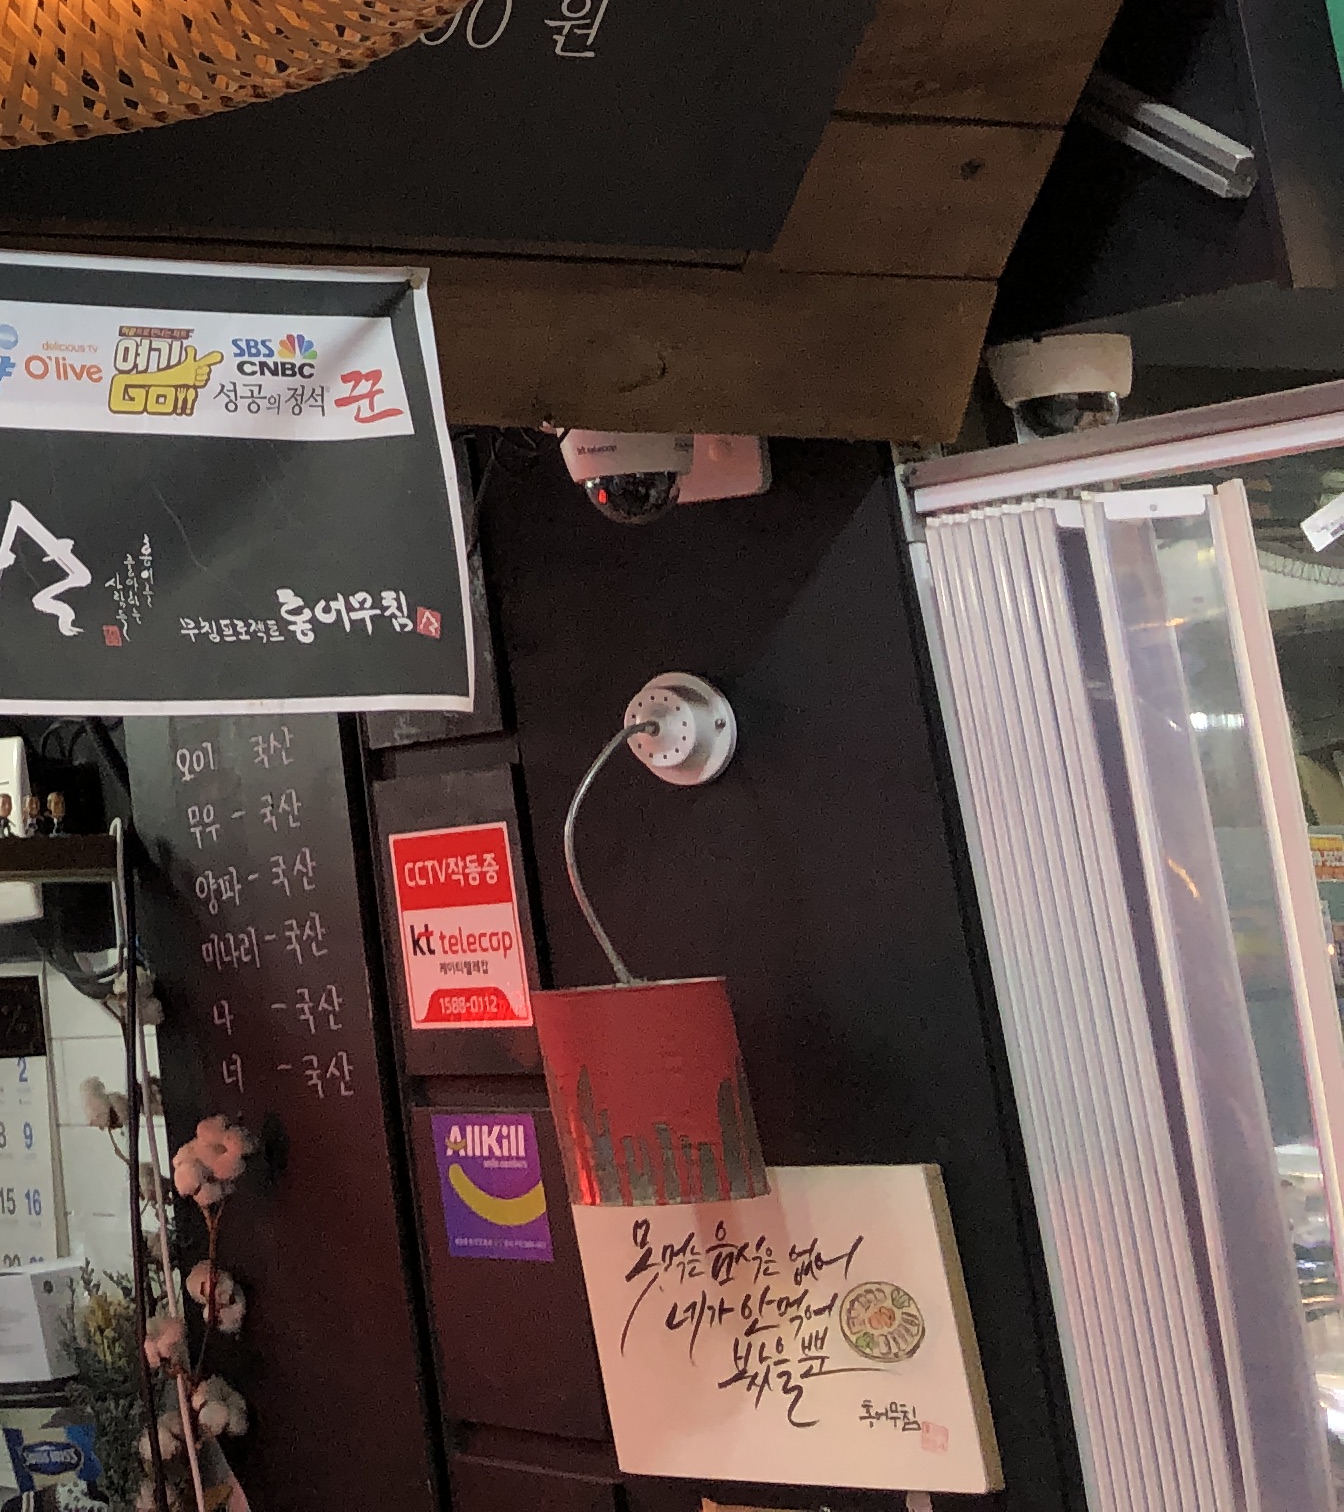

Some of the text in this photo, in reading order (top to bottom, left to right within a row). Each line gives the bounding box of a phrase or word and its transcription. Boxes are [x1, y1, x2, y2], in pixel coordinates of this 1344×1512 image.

[231, 337, 273, 359] SBS
[236, 360, 315, 379] CNBC
[213, 370, 405, 423] 성공의 정석 꾼
[277, 589, 413, 643] 홍어무침
[176, 726, 294, 781] 오이 국산
[260, 789, 302, 832] 국산
[195, 847, 316, 915] 양파 국산
[202, 912, 328, 970] 미나리 국산
[439, 927, 513, 958] telecop
[296, 984, 343, 1034] 국산
[302, 1051, 355, 1099] 국산
[23, 1121, 34, 1149] 9
[446, 1125, 525, 1157] AllKill
[25, 1188, 42, 1215] 16
